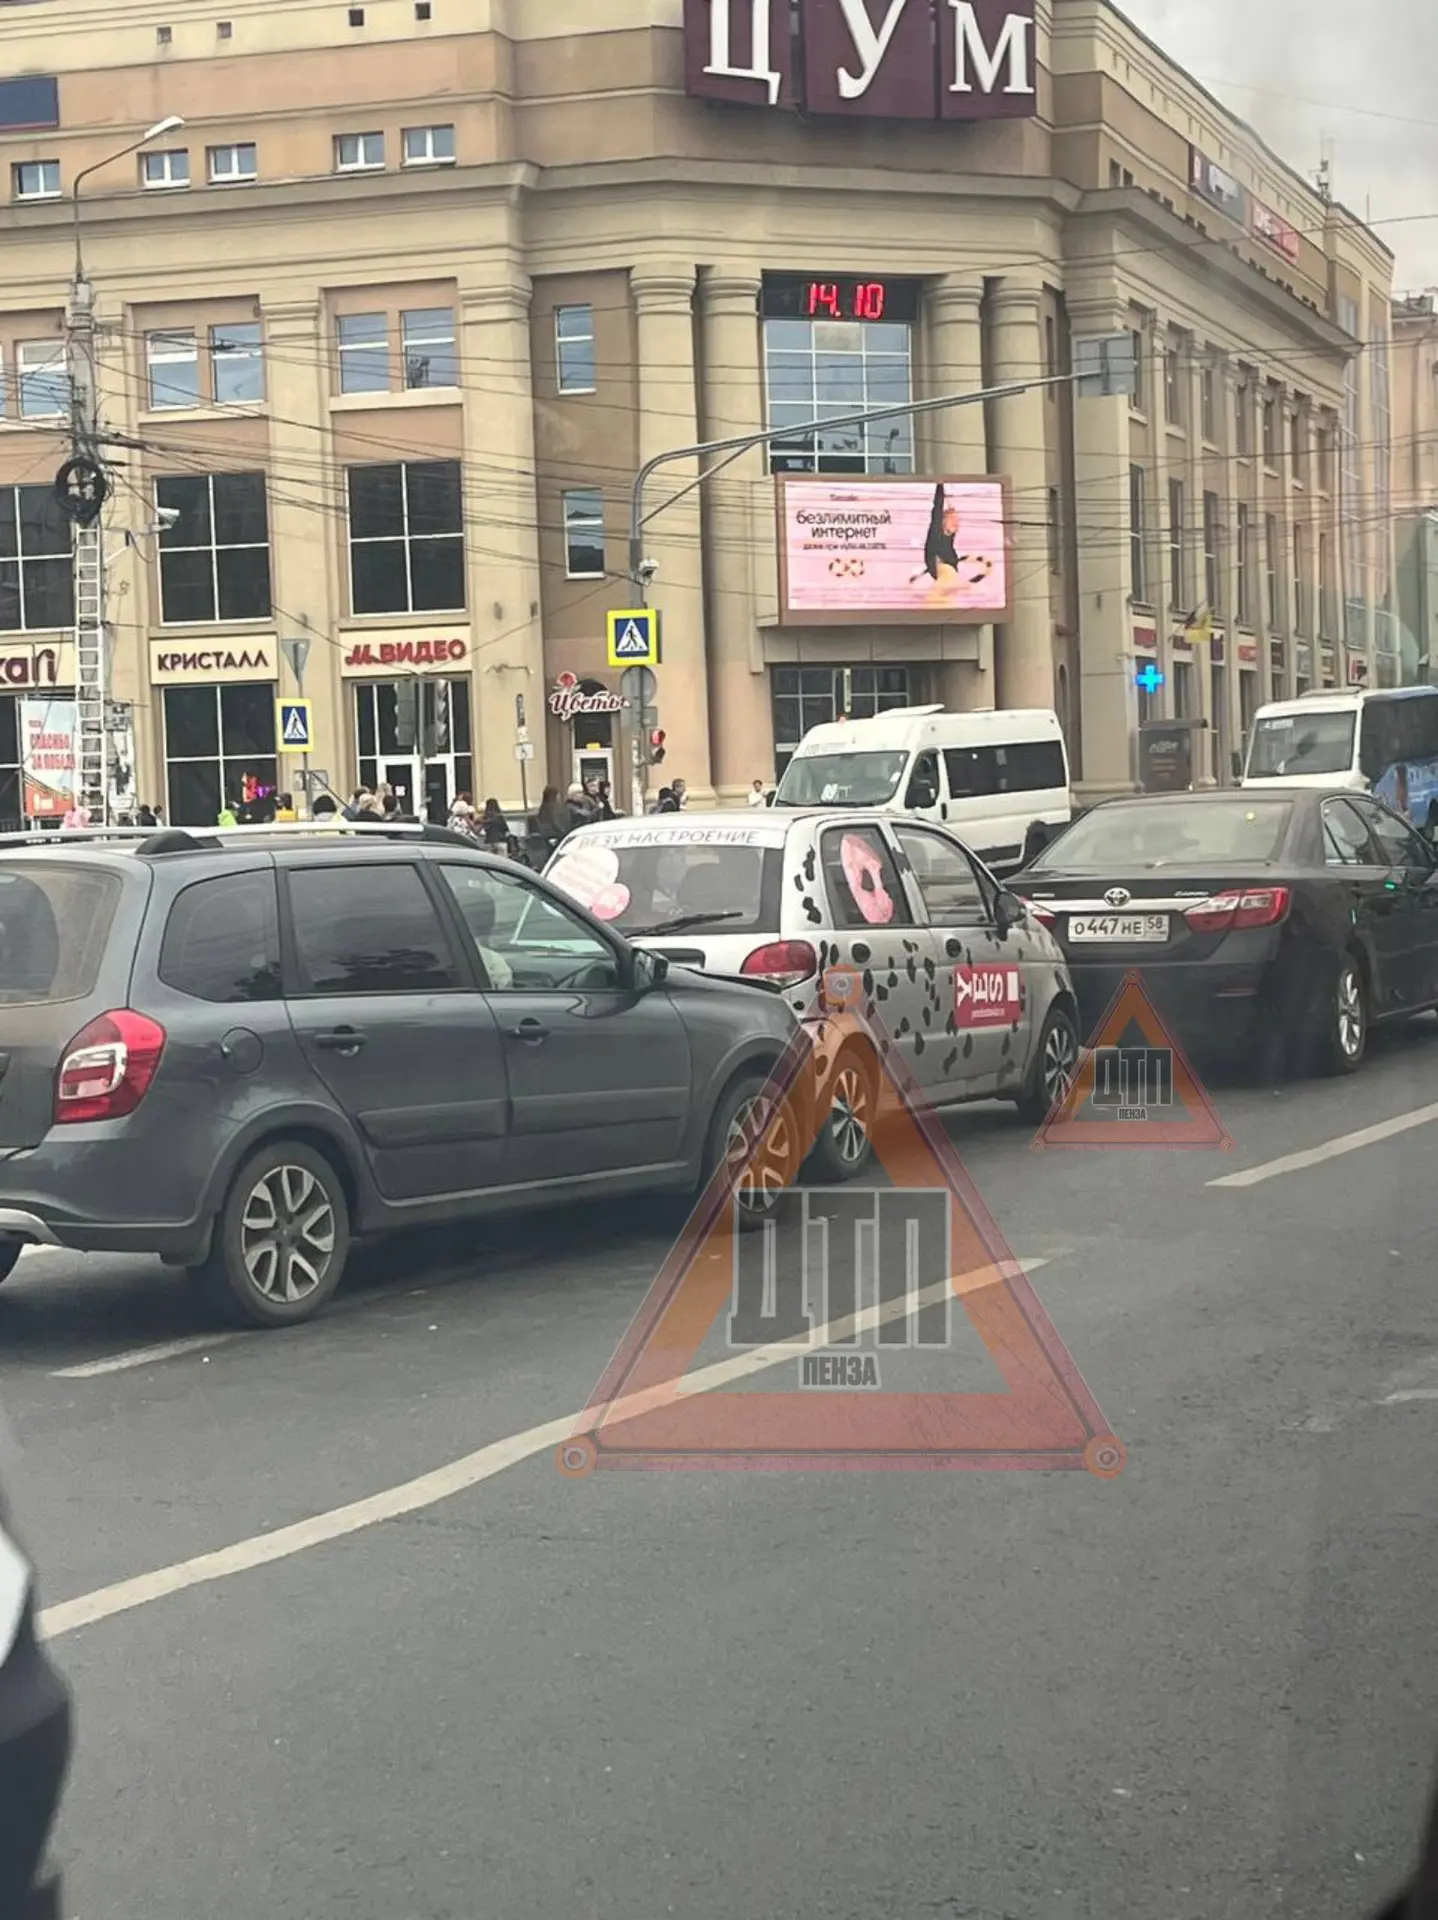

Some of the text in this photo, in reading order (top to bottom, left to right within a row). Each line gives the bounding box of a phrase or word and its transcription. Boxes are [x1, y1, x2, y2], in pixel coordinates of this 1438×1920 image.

[703, 0, 1034, 104] ЦУМ
[796, 509, 892, 524] безлимитный
[811, 526, 877, 541] интернет
[157, 650, 269, 671] КРИСТАЛЛ
[627, 829, 760, 845] НАСТРОЕНИЕ
